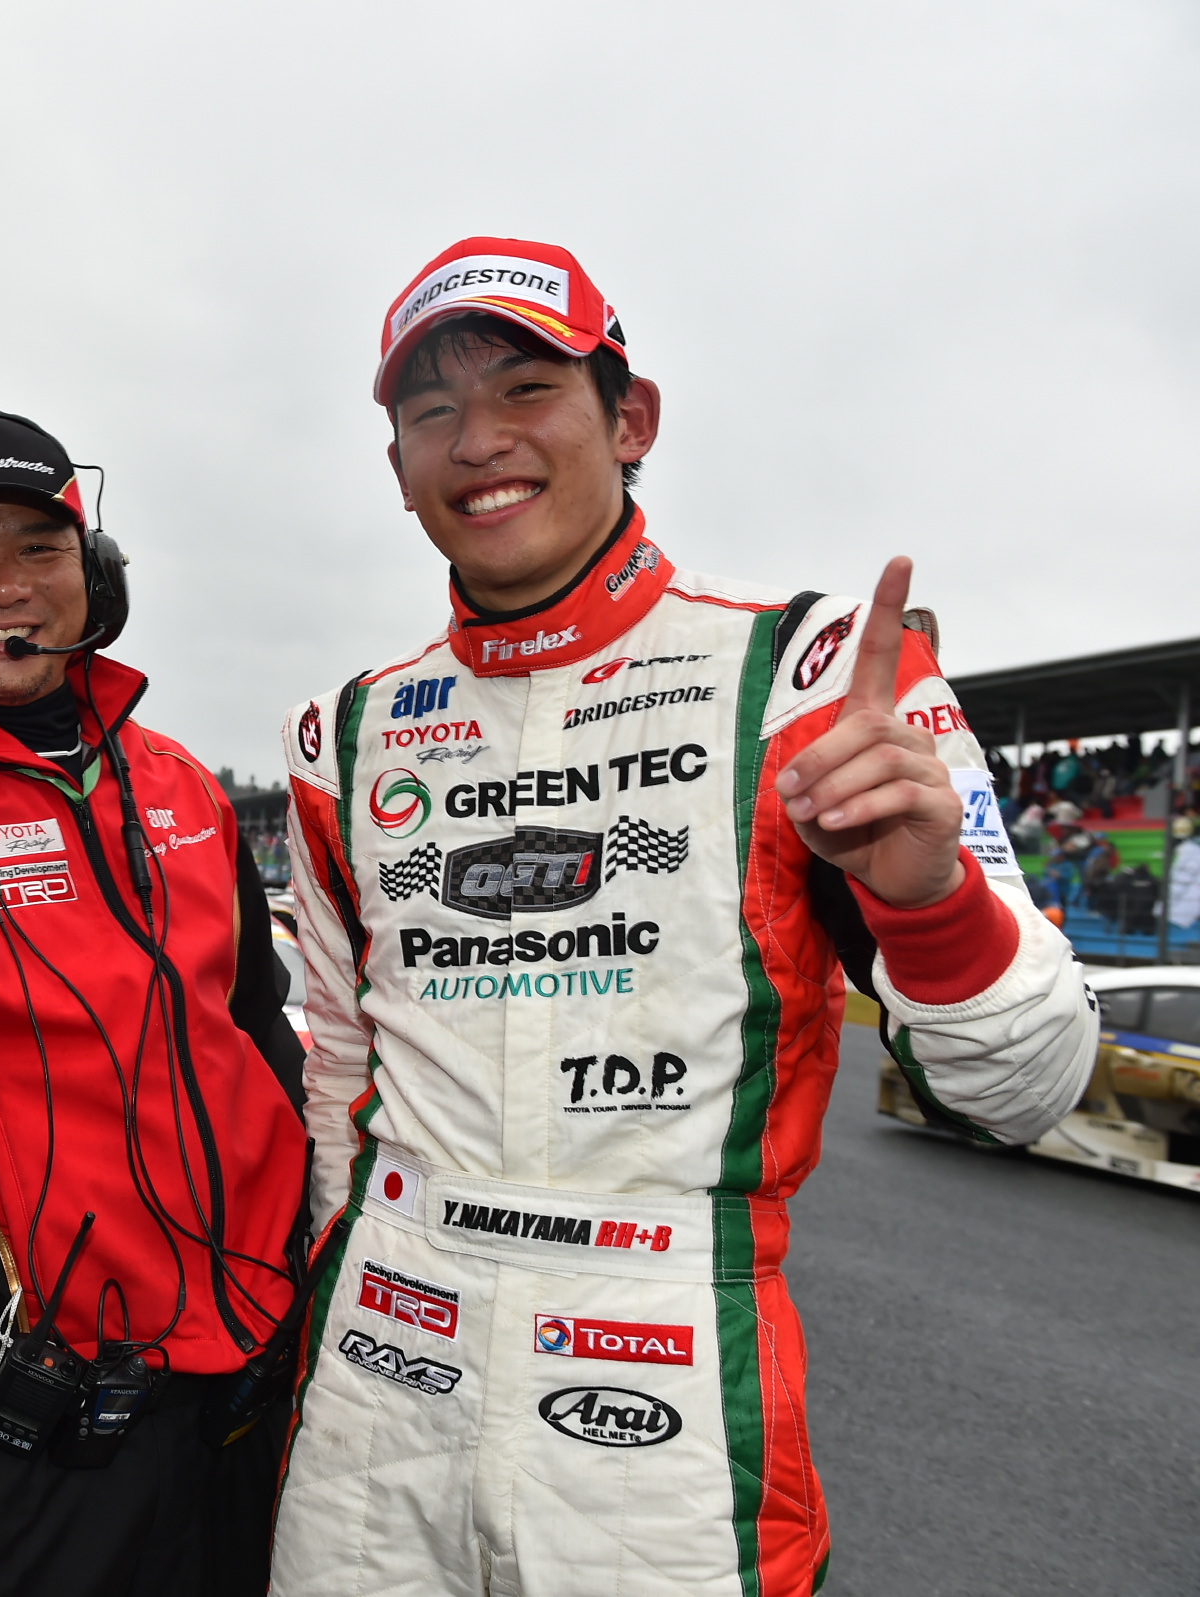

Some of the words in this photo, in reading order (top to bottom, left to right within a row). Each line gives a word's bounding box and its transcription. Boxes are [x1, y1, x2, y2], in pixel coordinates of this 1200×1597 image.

[397, 268, 561, 330] BRIDGESTONE
[481, 624, 579, 664] Firelex
[390, 675, 457, 720] apr
[563, 686, 716, 730] BRIDGESTONE
[381, 720, 483, 750] TOYOTA
[416, 744, 492, 765] Racing
[445, 765, 600, 819] GREEN
[608, 743, 708, 792] TEC
[14, 862, 68, 876] Development
[0, 878, 69, 904] TRD
[400, 912, 660, 968] Panasonic
[420, 968, 634, 1001] AUTOMOTIVE
[560, 1051, 688, 1104] T.D.P.
[592, 1105, 618, 1113] YOUNG
[442, 1200, 591, 1246] Y.NAKAYAMA
[594, 1220, 673, 1252] RH+B
[364, 1261, 392, 1281] Racing
[392, 1270, 459, 1302] Development
[365, 1280, 452, 1329] TRD
[341, 1332, 459, 1390] RAYS
[579, 1329, 687, 1356] TOTAL
[27, 1369, 55, 1385] KENWOOD
[347, 1353, 438, 1395] ENGINEERING
[548, 1391, 665, 1432] Arai
[582, 1427, 634, 1442] HELMET
